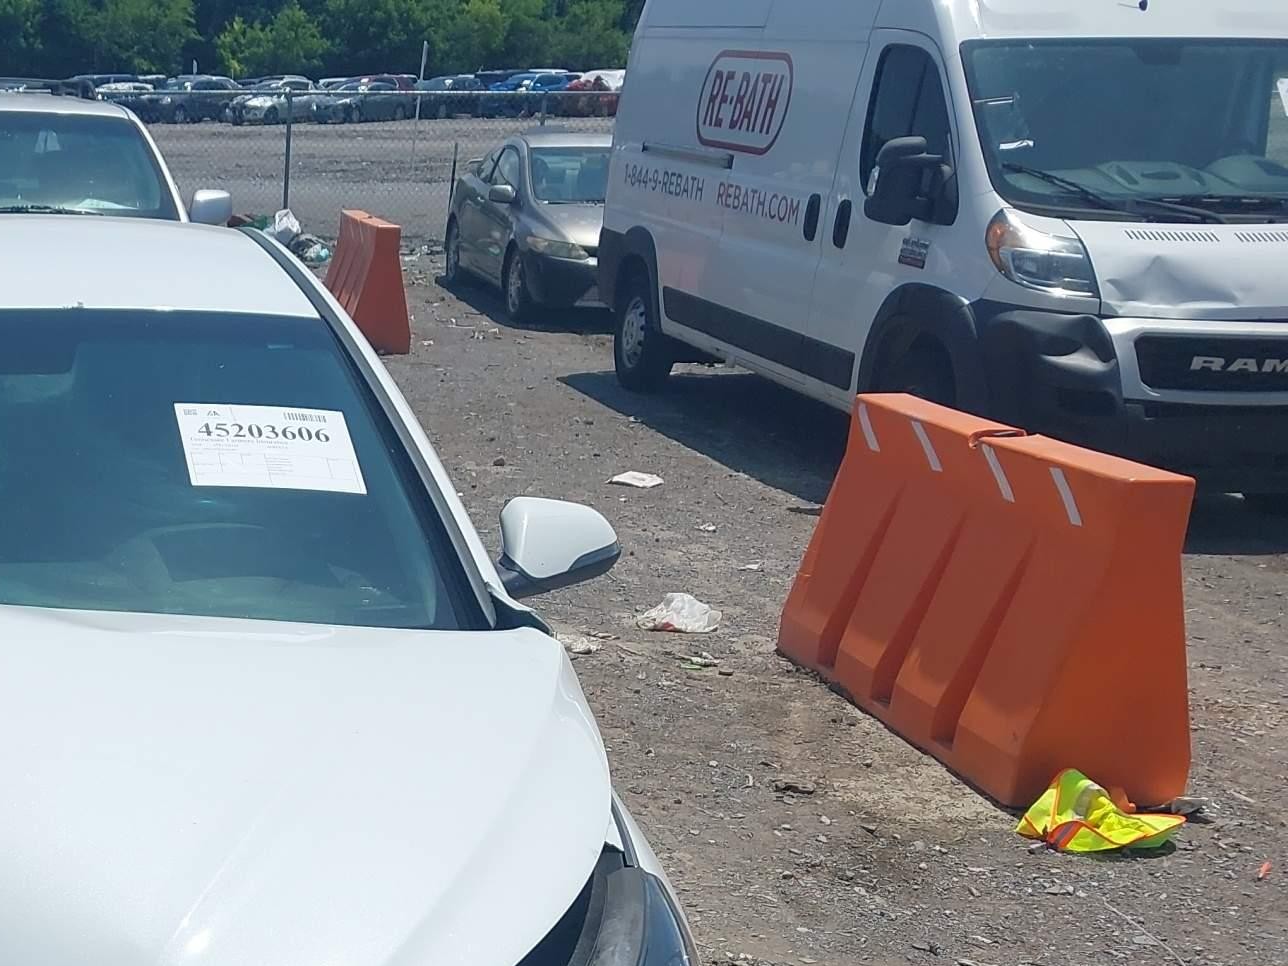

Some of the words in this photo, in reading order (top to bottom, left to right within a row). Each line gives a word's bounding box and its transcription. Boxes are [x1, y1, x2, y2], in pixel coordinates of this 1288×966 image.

[624, 163, 705, 201] 1-844-9-REBATH
[716, 182, 800, 225] REBATH.COM
[1190, 355, 1288, 373] RAM
[197, 422, 331, 443] 45203606
